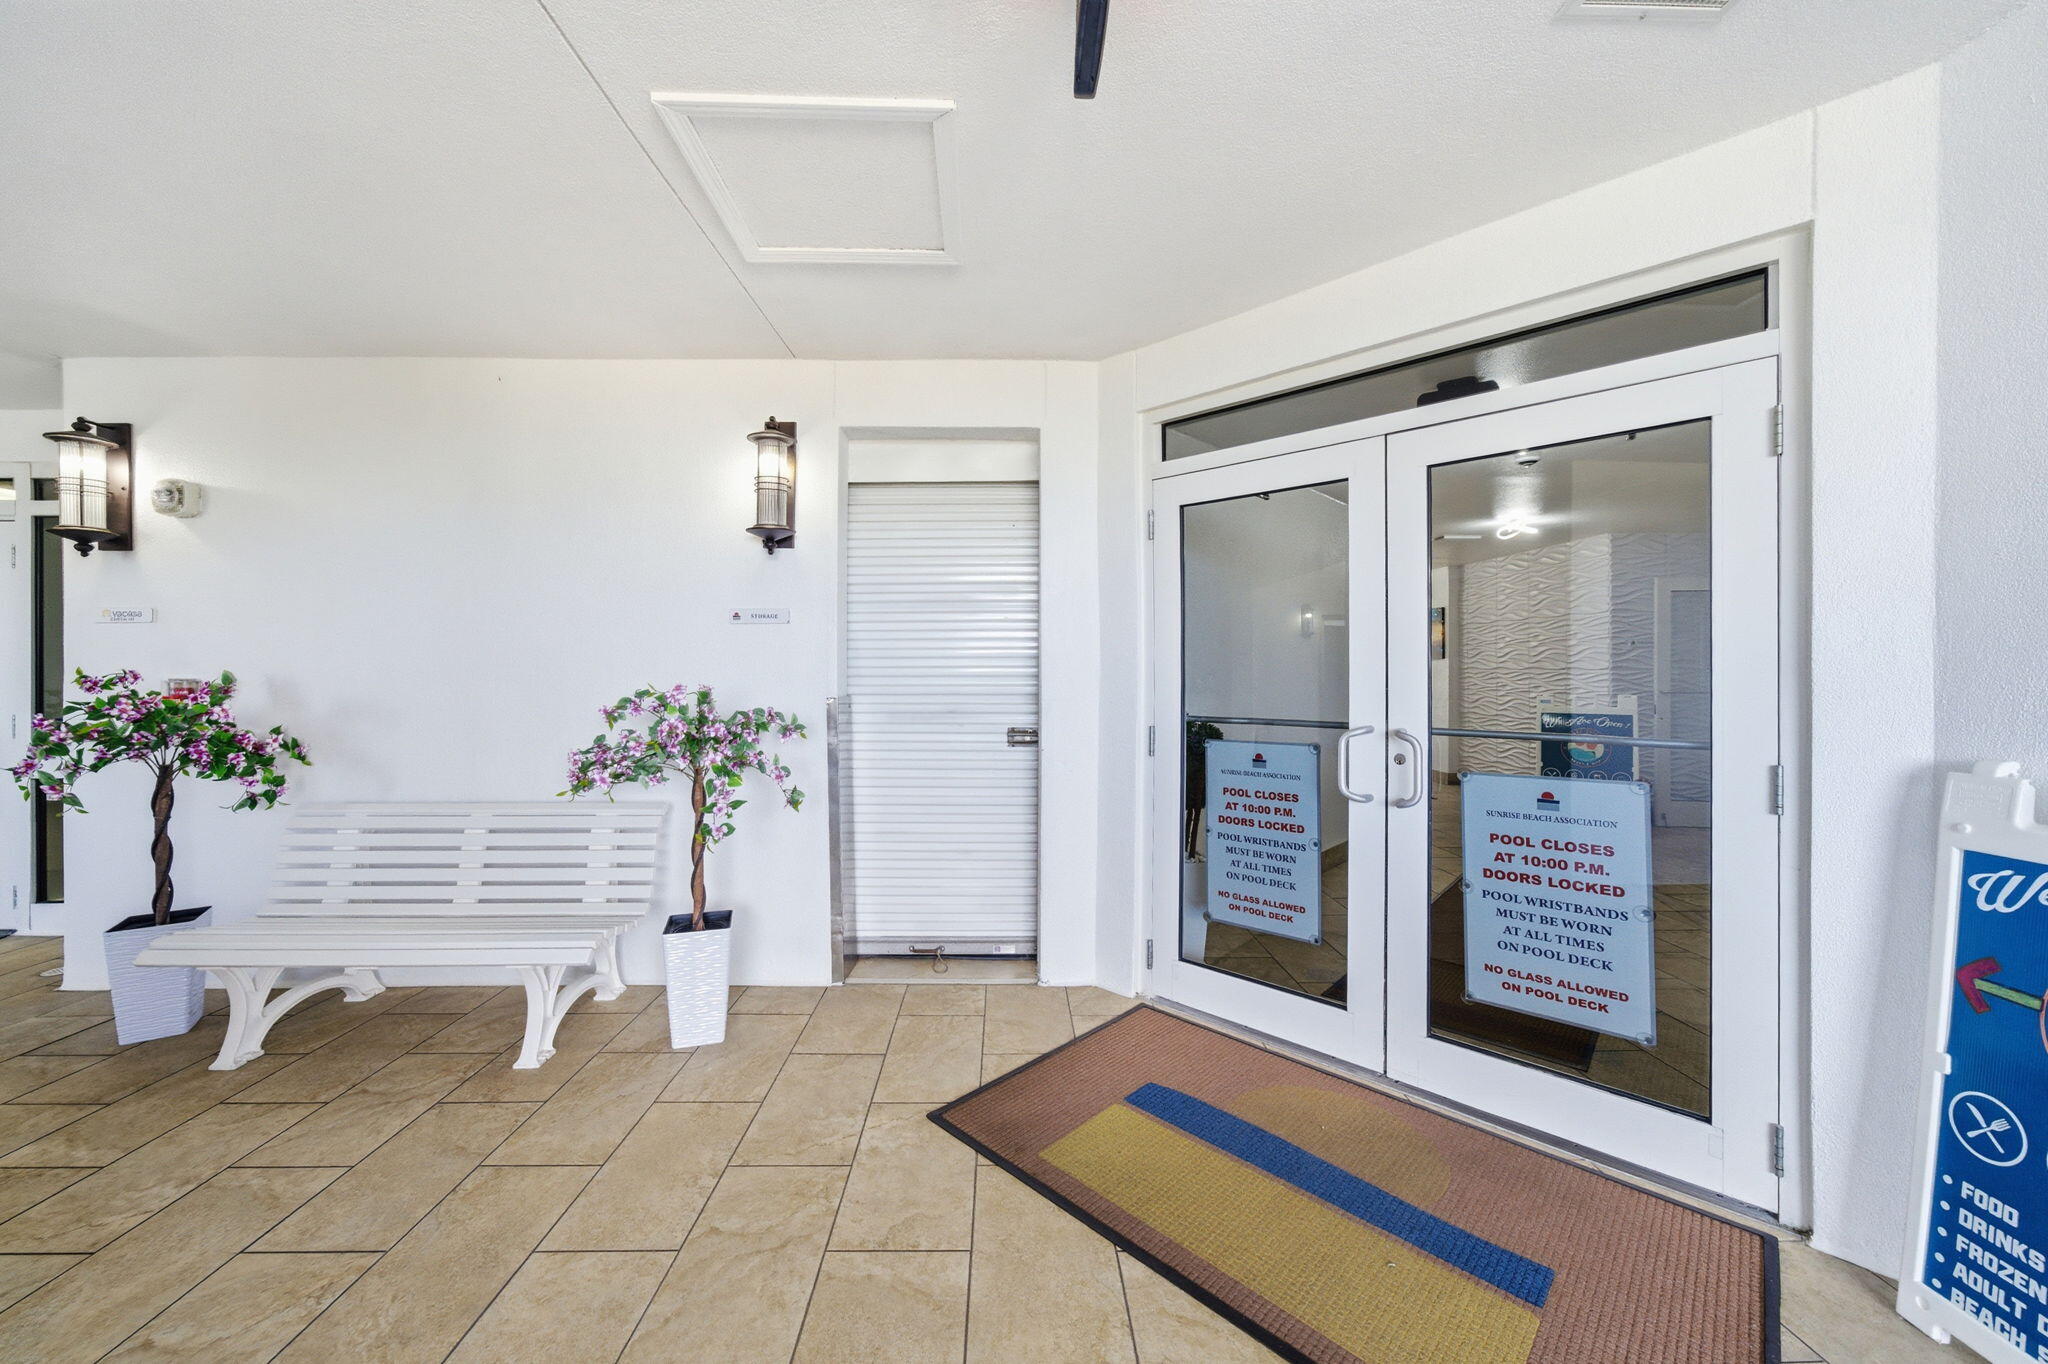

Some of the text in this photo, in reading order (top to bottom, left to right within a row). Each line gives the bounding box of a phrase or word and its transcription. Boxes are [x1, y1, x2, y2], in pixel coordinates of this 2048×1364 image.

[1243, 770, 1262, 778] BEACH
[1262, 772, 1301, 781] ASSOCIATION
[1222, 787, 1299, 803] POOL CLOSES
[1225, 802, 1296, 818] AT 10:00 P.M.
[1486, 810, 1618, 829] SUNRISE BEACH ASSOCIATION
[1218, 815, 1305, 834] DOORS LOCKED
[1218, 832, 1307, 852] POOL WRISTBANDS
[1226, 846, 1297, 864] MUST BE WORN
[1489, 832, 1615, 858] POOL CLOSES
[1230, 859, 1292, 876] AT ALL TIMES
[1494, 852, 1610, 876] AT 10:00 P.M.
[1226, 871, 1297, 892] ON POOL DECK
[1482, 867, 1626, 898] DOORS LOCKED
[1218, 890, 1306, 914] NO GLASS ALLOWED
[1228, 903, 1294, 924] ON POOL DECK
[1482, 889, 1629, 922] POOL WRISTBANDS
[1496, 908, 1613, 936] MUST BE WORN
[1502, 925, 1605, 953] AT ALL TIMES
[1497, 940, 1614, 972] ON POOL DECK
[1484, 963, 1629, 1002] NO GLASS ALLOWED
[1502, 981, 1610, 1014] ON POOL DECK
[1960, 1180, 2020, 1229] FOOD
[1958, 1207, 2046, 1274] DRINKS
[1956, 1233, 2048, 1306] FROZEN
[1952, 1262, 2028, 1320] ADULT
[1950, 1287, 2028, 1352] BEACH
